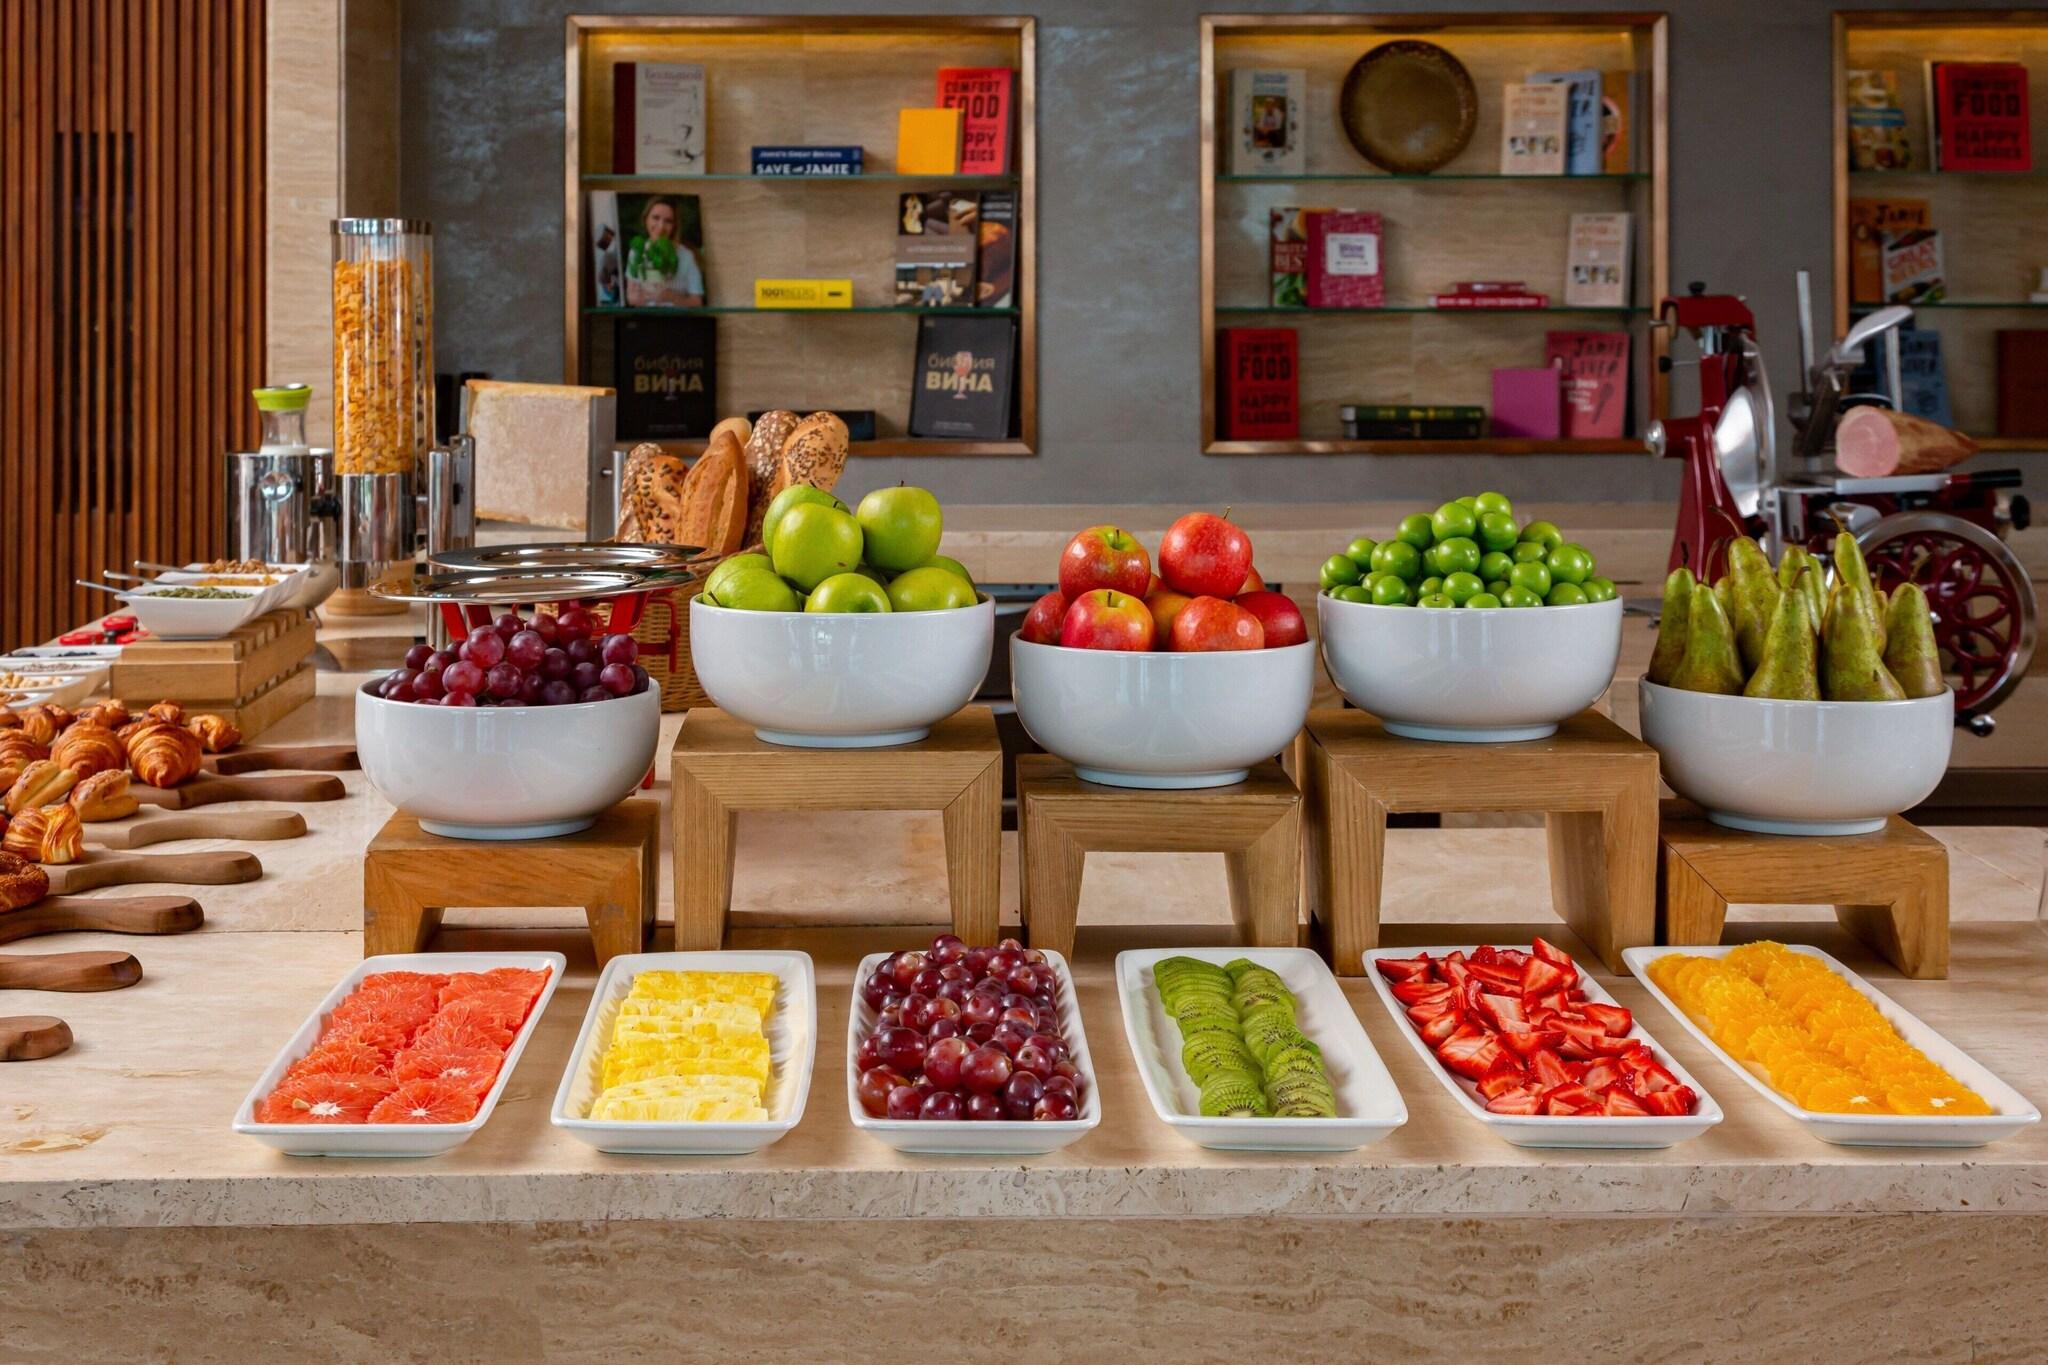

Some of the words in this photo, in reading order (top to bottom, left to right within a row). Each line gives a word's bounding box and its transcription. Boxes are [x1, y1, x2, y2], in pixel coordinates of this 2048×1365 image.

[945, 81, 1000, 93] COMFORT
[944, 95, 999, 119] FOOD
[1953, 93, 2021, 117] FOOD
[756, 163, 791, 175] SAVE
[804, 163, 850, 175] JAMIE
[1238, 356, 1292, 381] FOOD
[633, 373, 705, 393] ВИНА
[925, 371, 993, 393] ВИНА
